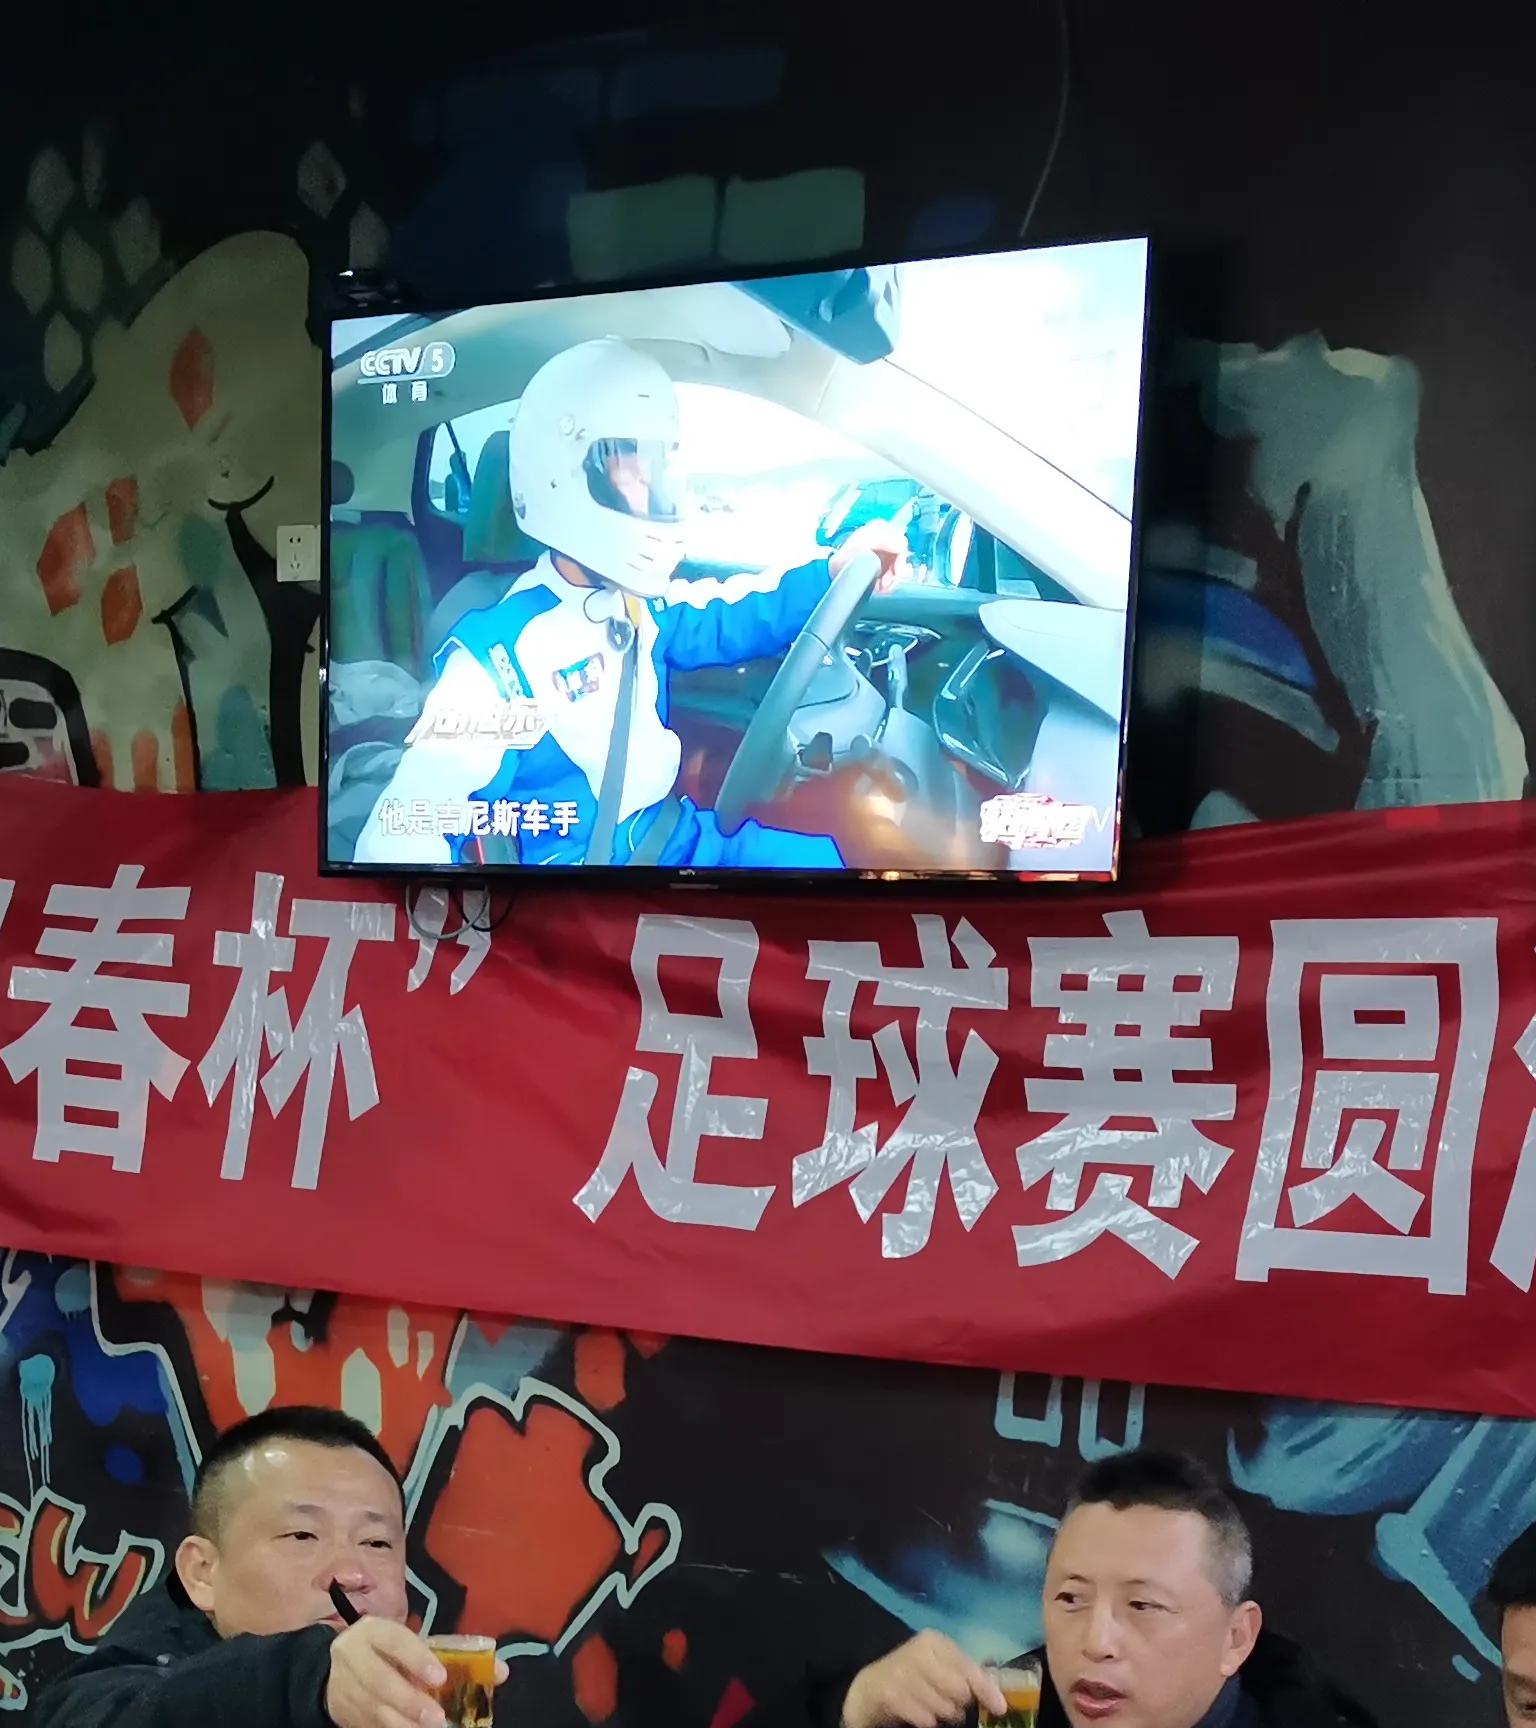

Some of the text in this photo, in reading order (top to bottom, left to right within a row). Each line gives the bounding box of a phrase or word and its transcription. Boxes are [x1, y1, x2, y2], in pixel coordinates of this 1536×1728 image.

[360, 346, 445, 378] CCTV 5
[378, 798, 580, 837] 他是吉尼斯车手
